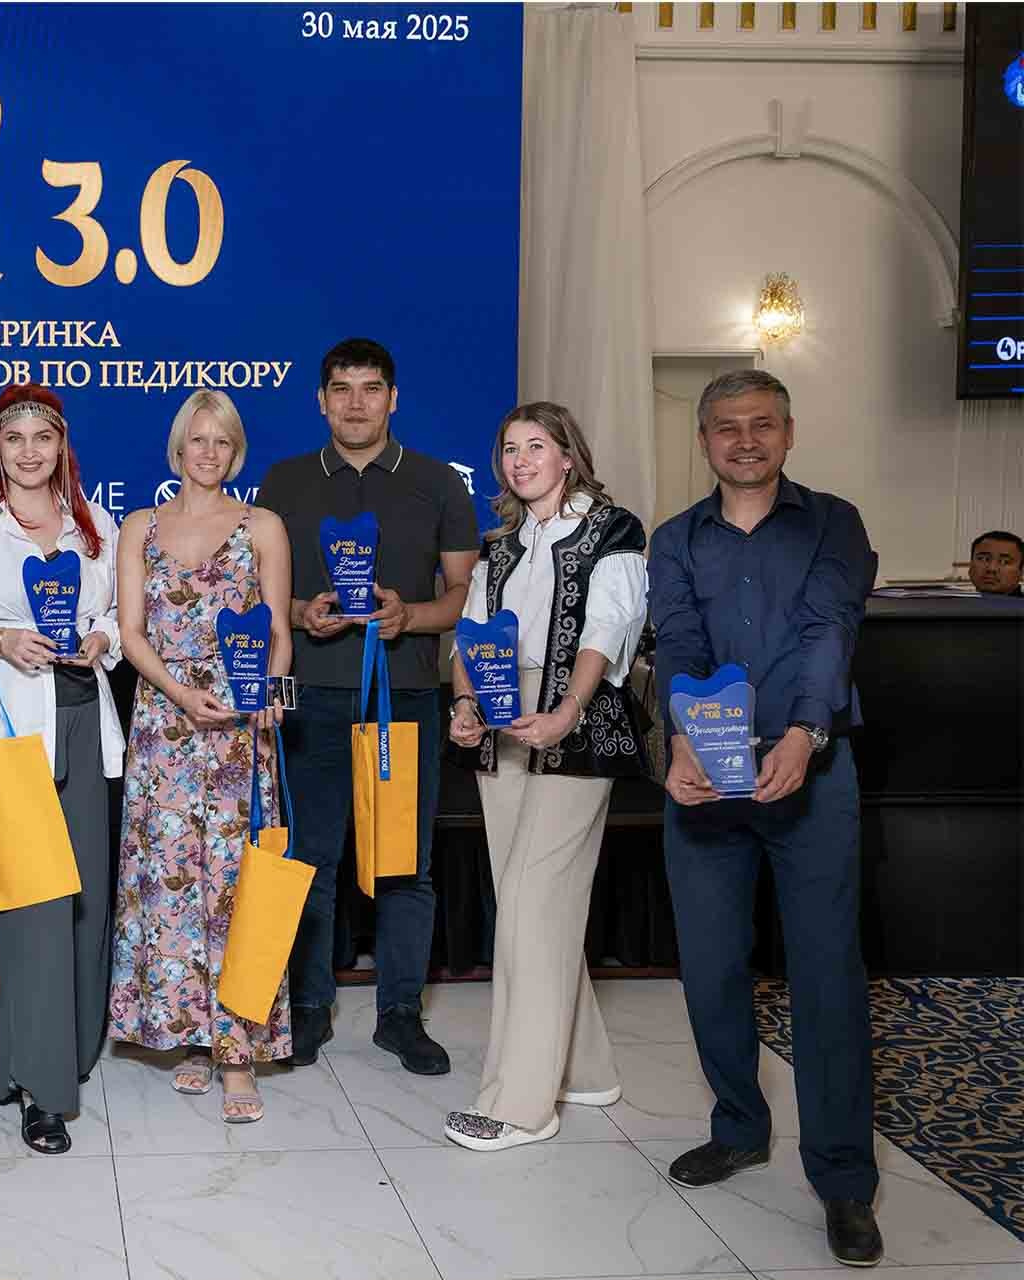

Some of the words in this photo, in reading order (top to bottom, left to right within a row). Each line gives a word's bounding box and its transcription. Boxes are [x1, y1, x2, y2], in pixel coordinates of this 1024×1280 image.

[302, 12, 333, 37] 30
[343, 21, 397, 39] мая
[407, 14, 468, 40] 2025
[36, 160, 224, 286] 3.0
[40, 361, 91, 387] ПО
[100, 361, 292, 392] ПЕДИКЮРУ
